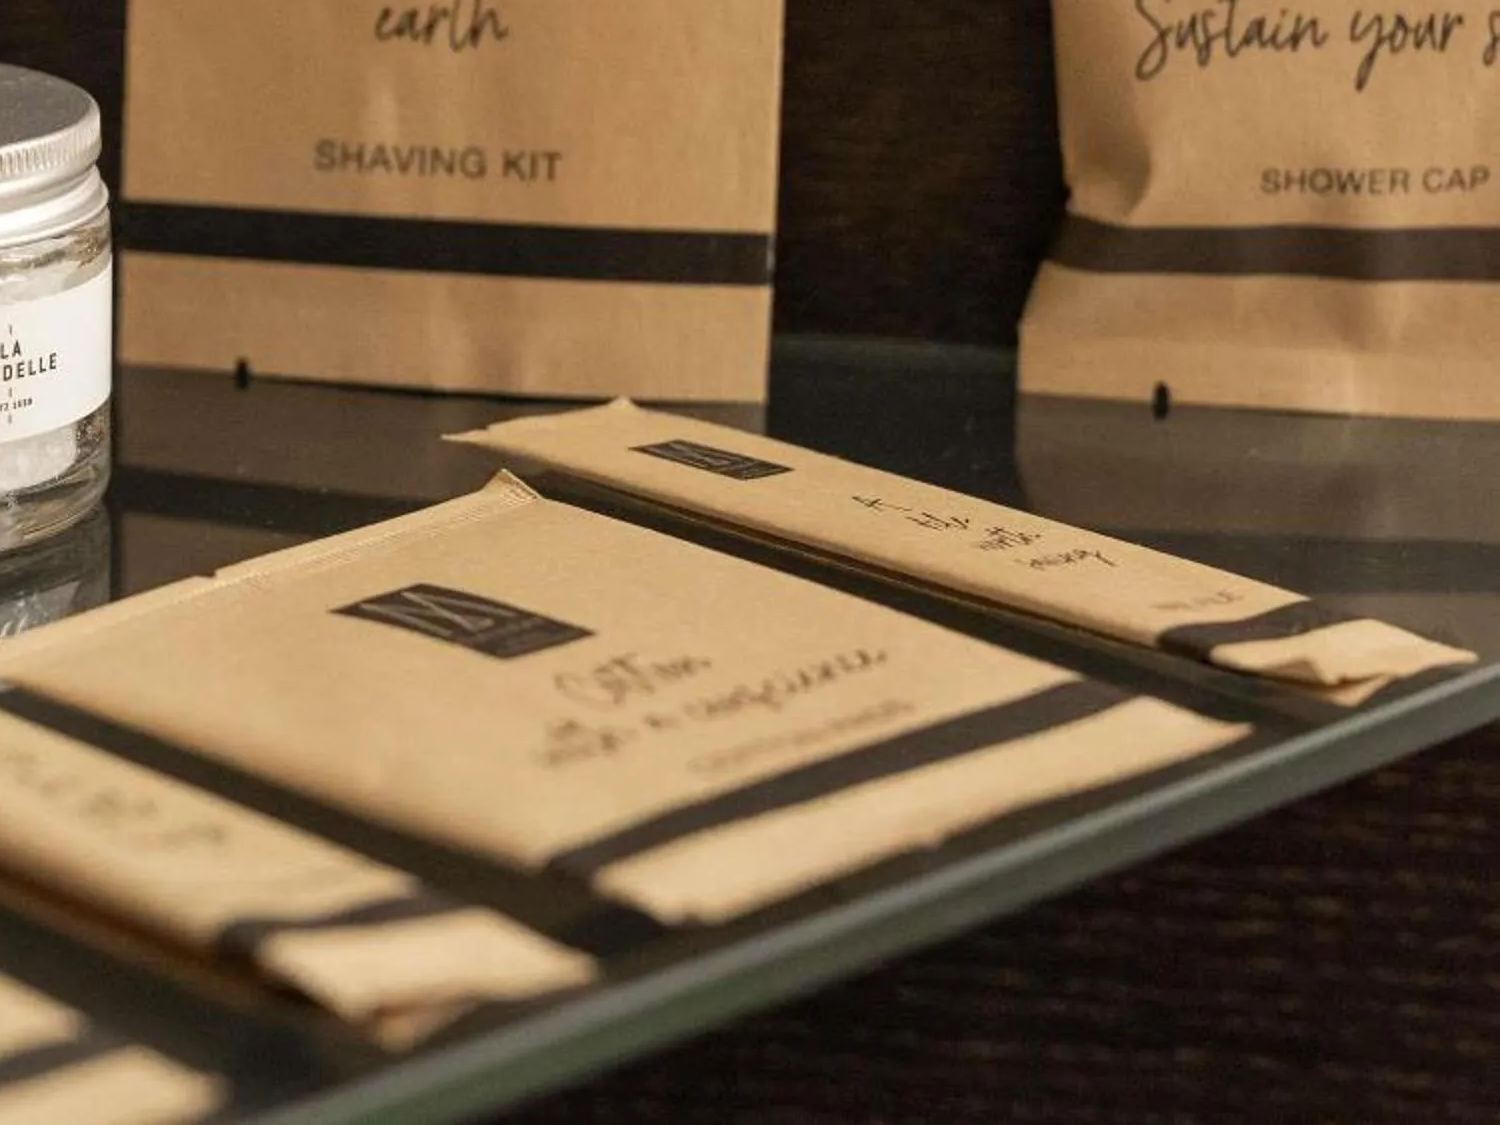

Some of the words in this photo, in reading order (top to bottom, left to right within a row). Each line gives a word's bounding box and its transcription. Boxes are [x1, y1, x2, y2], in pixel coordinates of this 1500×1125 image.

[1349, 9, 1465, 92] your
[313, 139, 489, 178] SHAVING
[501, 149, 563, 182] KIT
[1260, 167, 1411, 196] SHOWER
[1421, 166, 1492, 194] CAP
[0, 339, 22, 360] LA
